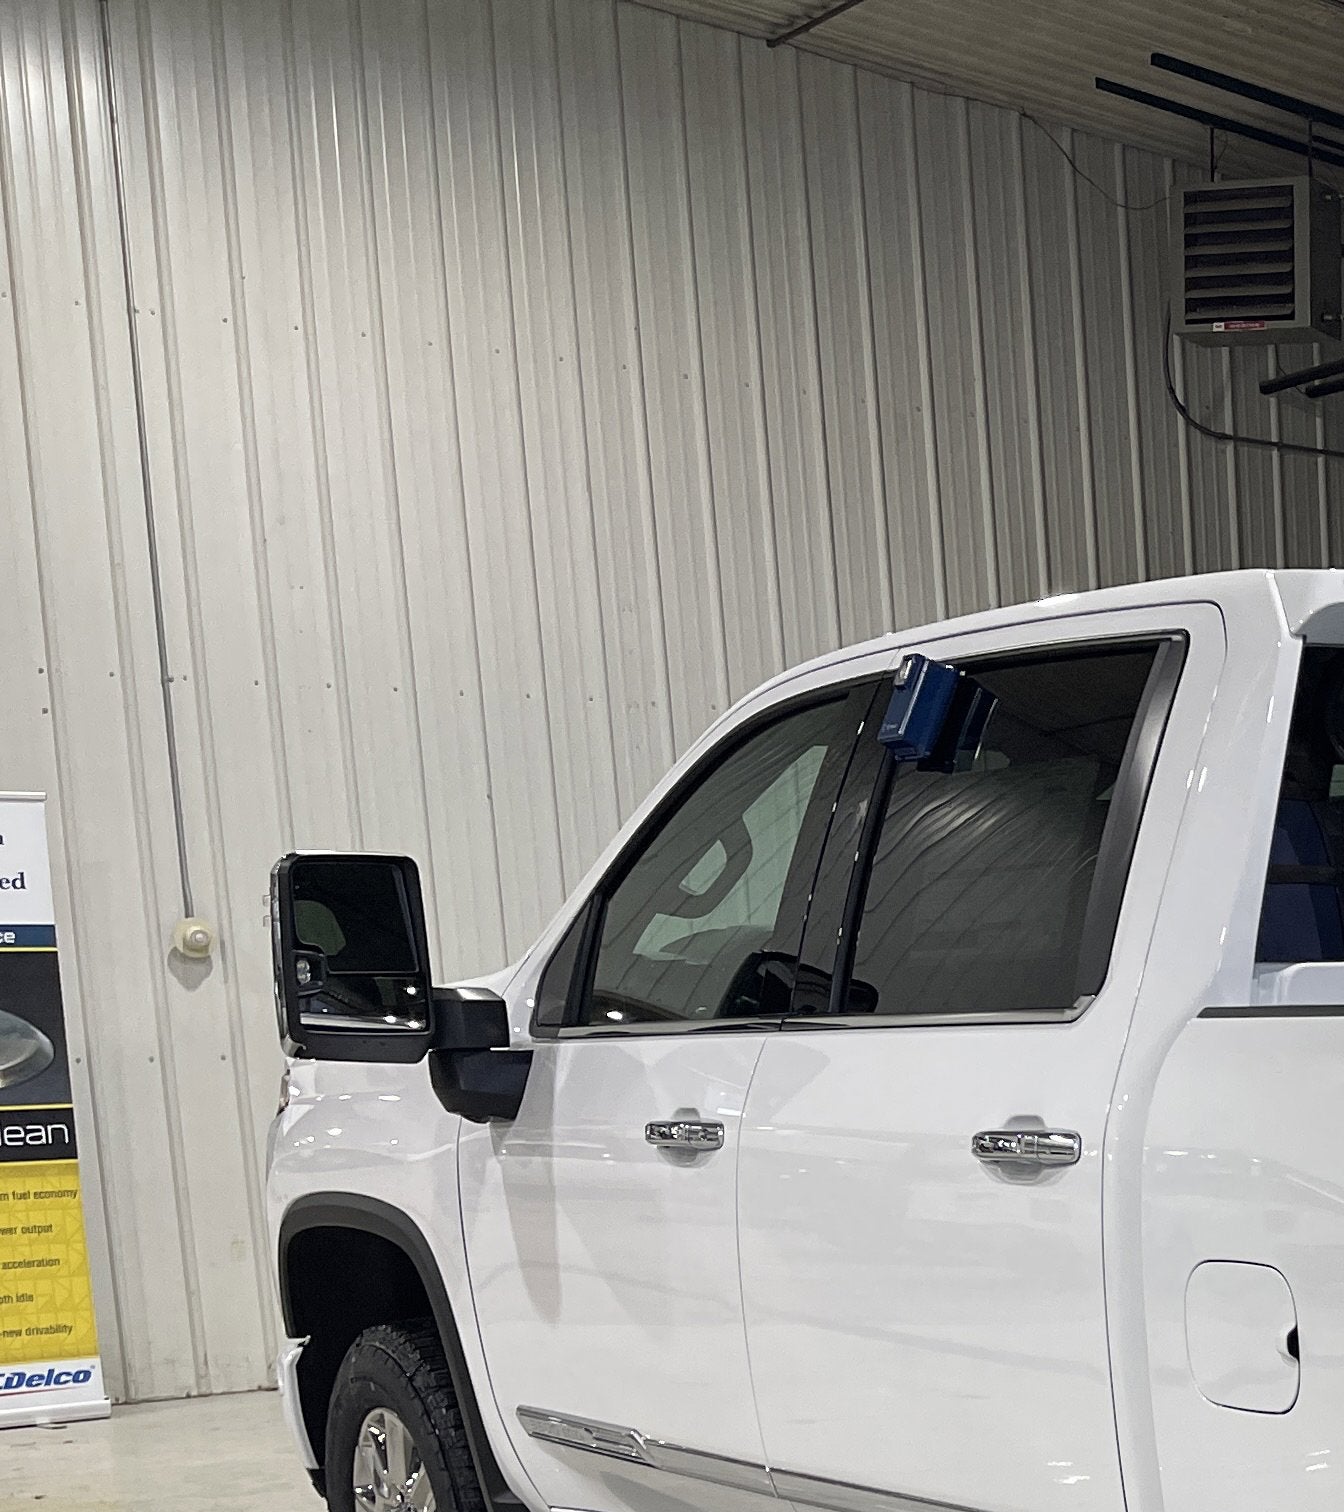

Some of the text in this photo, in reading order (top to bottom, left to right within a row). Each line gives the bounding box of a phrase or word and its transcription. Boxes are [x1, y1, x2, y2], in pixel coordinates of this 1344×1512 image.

[0, 1123, 70, 1147] ean
[12, 1190, 31, 1200] fuel
[34, 1188, 78, 1200] economy
[0, 1223, 53, 1237] wer output
[2, 1256, 61, 1270] acceleration
[25, 1323, 74, 1337] drivability
